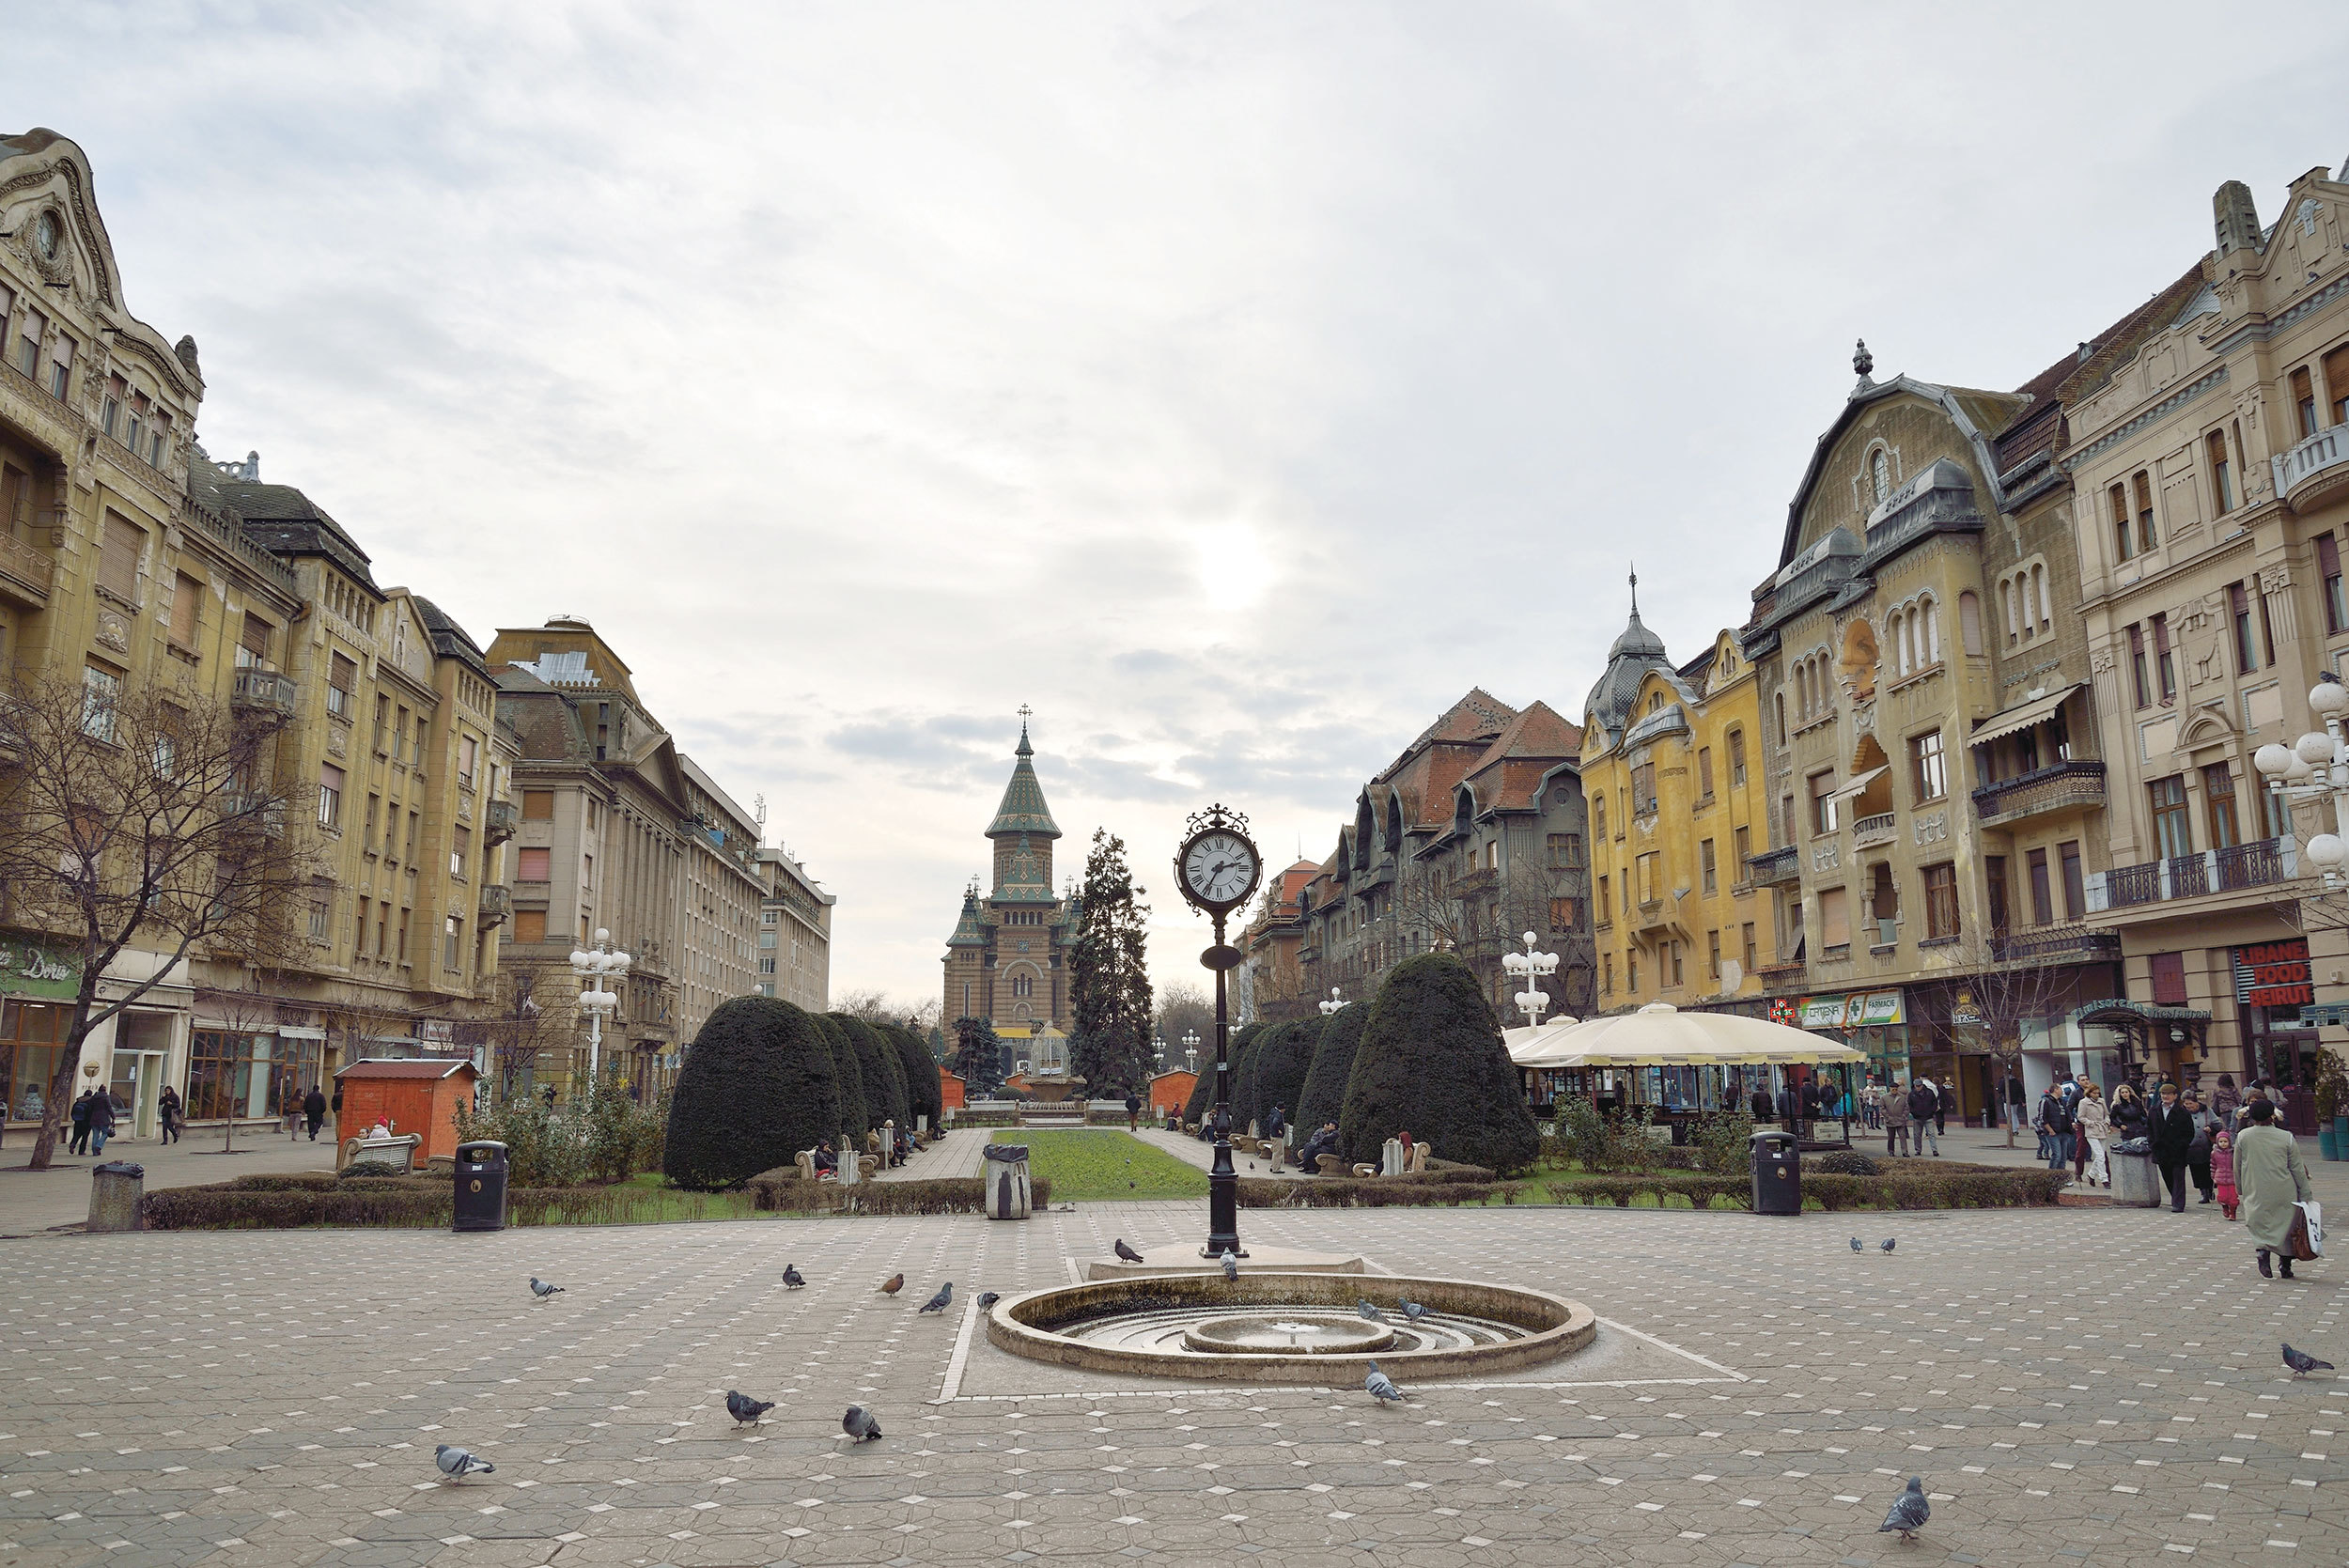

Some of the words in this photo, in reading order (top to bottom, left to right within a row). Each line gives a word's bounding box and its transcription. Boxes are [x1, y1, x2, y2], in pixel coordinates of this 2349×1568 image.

[2254, 963, 2308, 986] FOOD
[1868, 999, 1895, 1009] FARMACIE
[2248, 985, 2312, 1008] BEIRUT
